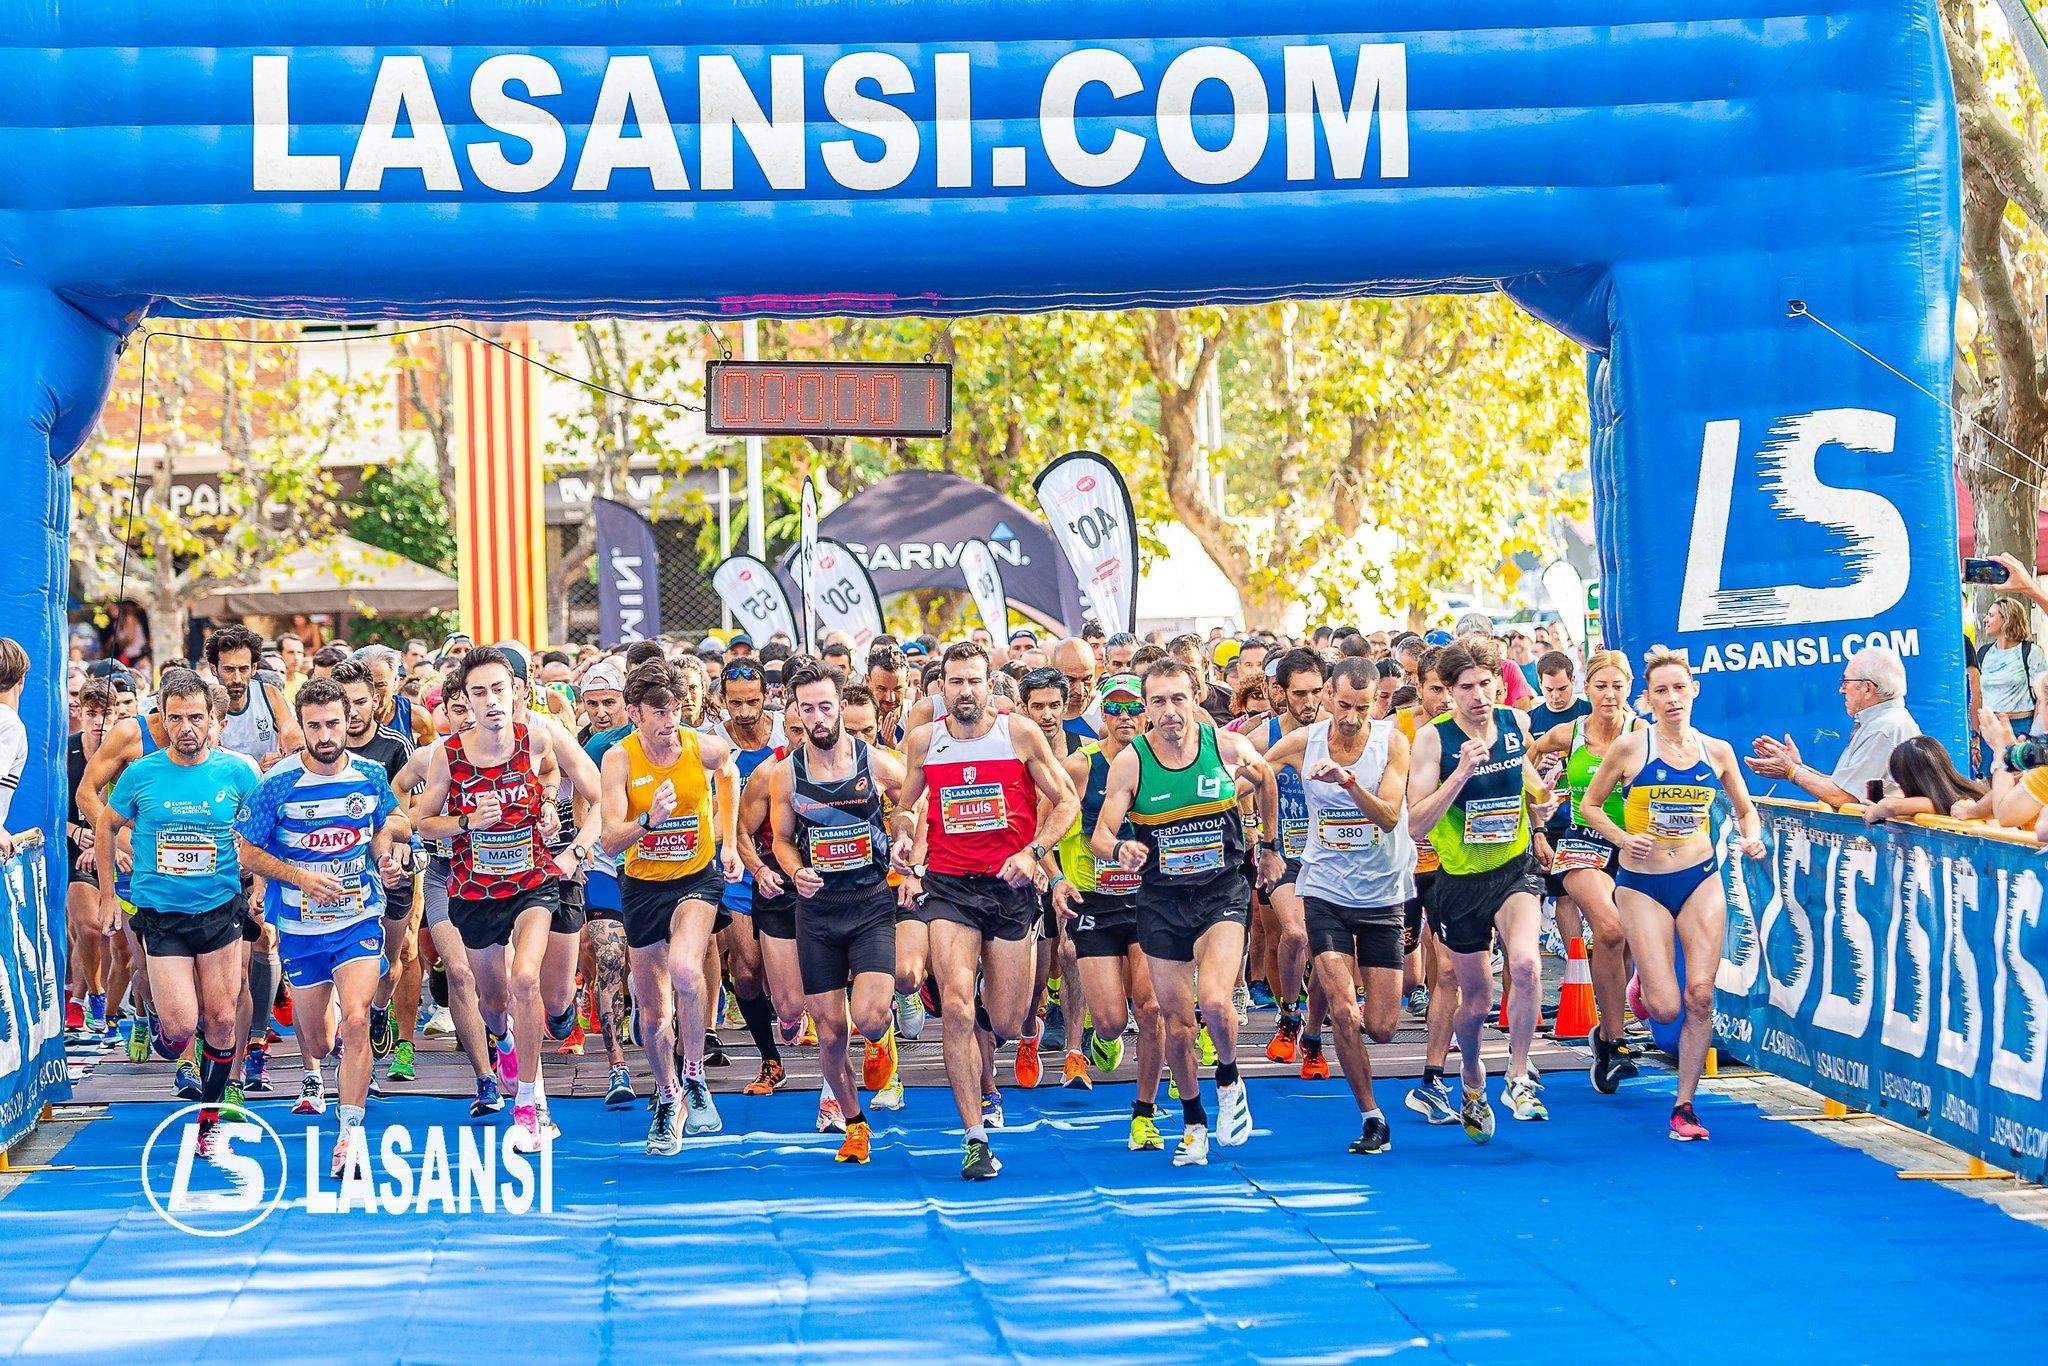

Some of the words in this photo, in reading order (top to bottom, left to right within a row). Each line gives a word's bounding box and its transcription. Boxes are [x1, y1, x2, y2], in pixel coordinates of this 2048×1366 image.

[251, 43, 1410, 192] LASANSI.COM
[1678, 407, 1911, 632] LS
[1338, 827, 1363, 838] 380
[655, 834, 687, 846] JACK
[488, 849, 523, 860] MARC
[830, 843, 857, 855] ERIC
[177, 852, 199, 862] 391
[1183, 853, 1207, 864] 361
